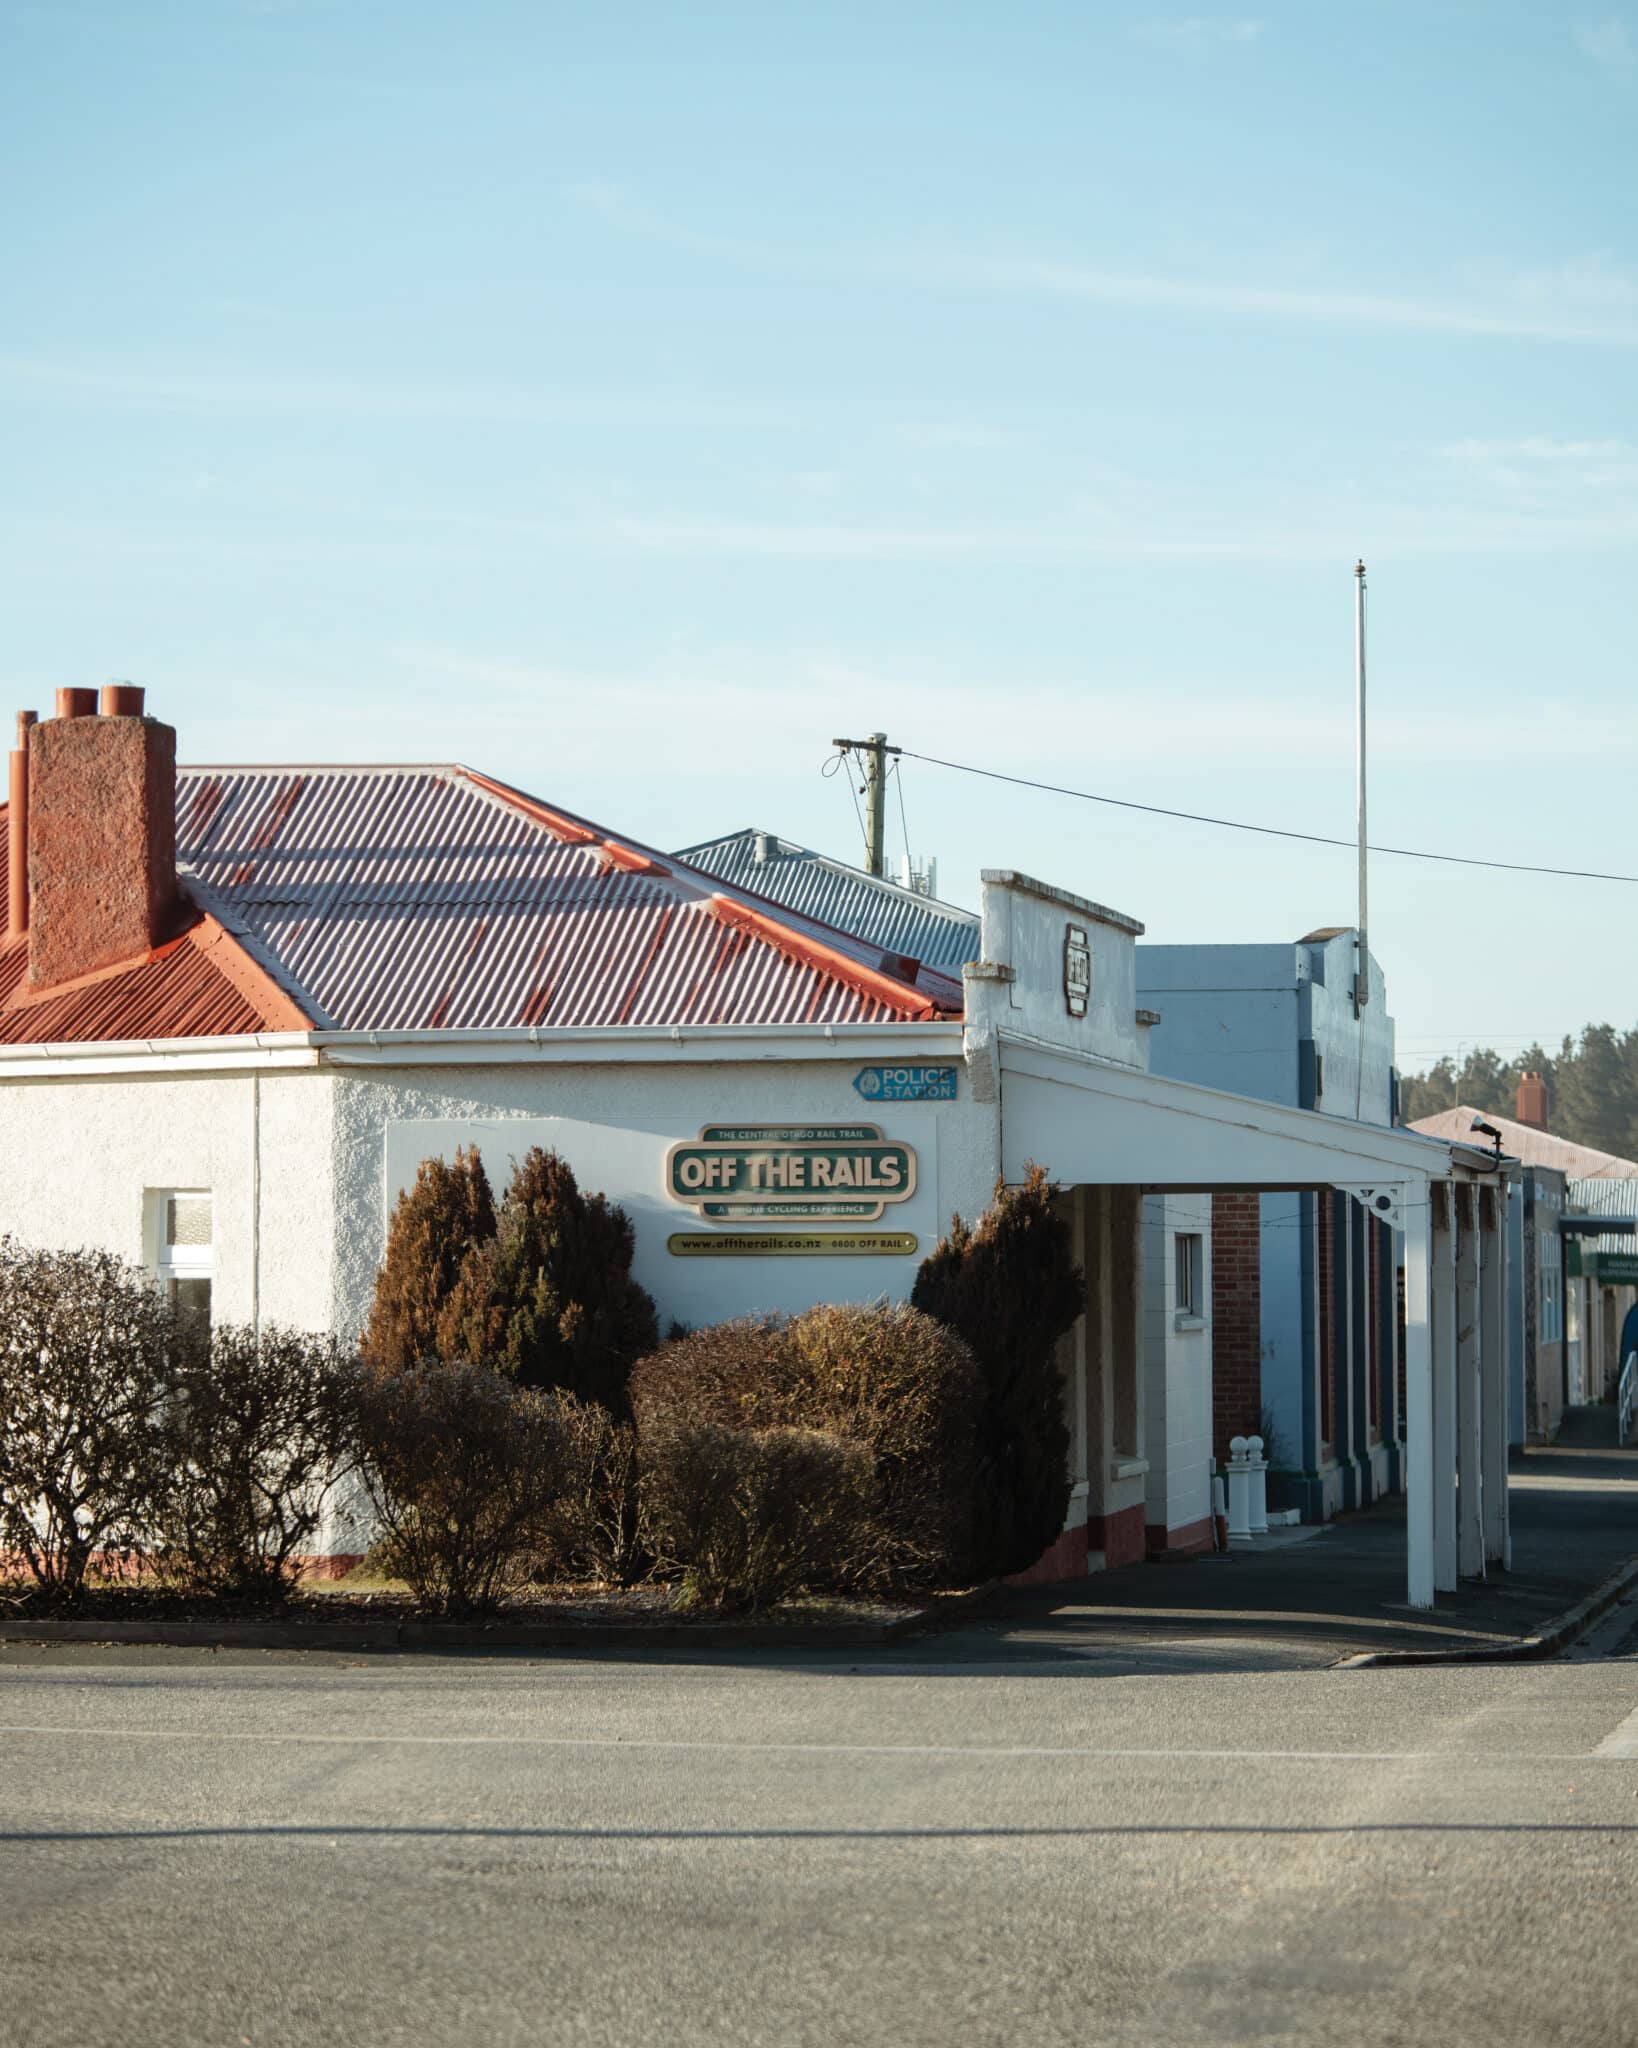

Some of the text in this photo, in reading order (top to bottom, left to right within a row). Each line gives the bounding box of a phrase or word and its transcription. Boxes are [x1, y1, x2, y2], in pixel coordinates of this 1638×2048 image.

[884, 1069, 949, 1084] POLICE
[884, 1086, 950, 1097] STATION
[719, 1130, 865, 1139] THE CENTRAL OTAGO RAIL TRAIL
[680, 1156, 901, 1187] OFF THE RAILS
[718, 1205, 725, 1213] A
[768, 1205, 808, 1213] CYCLING
[682, 1238, 902, 1249] www.offtherails.co.nz 0800 OFF RAIL
